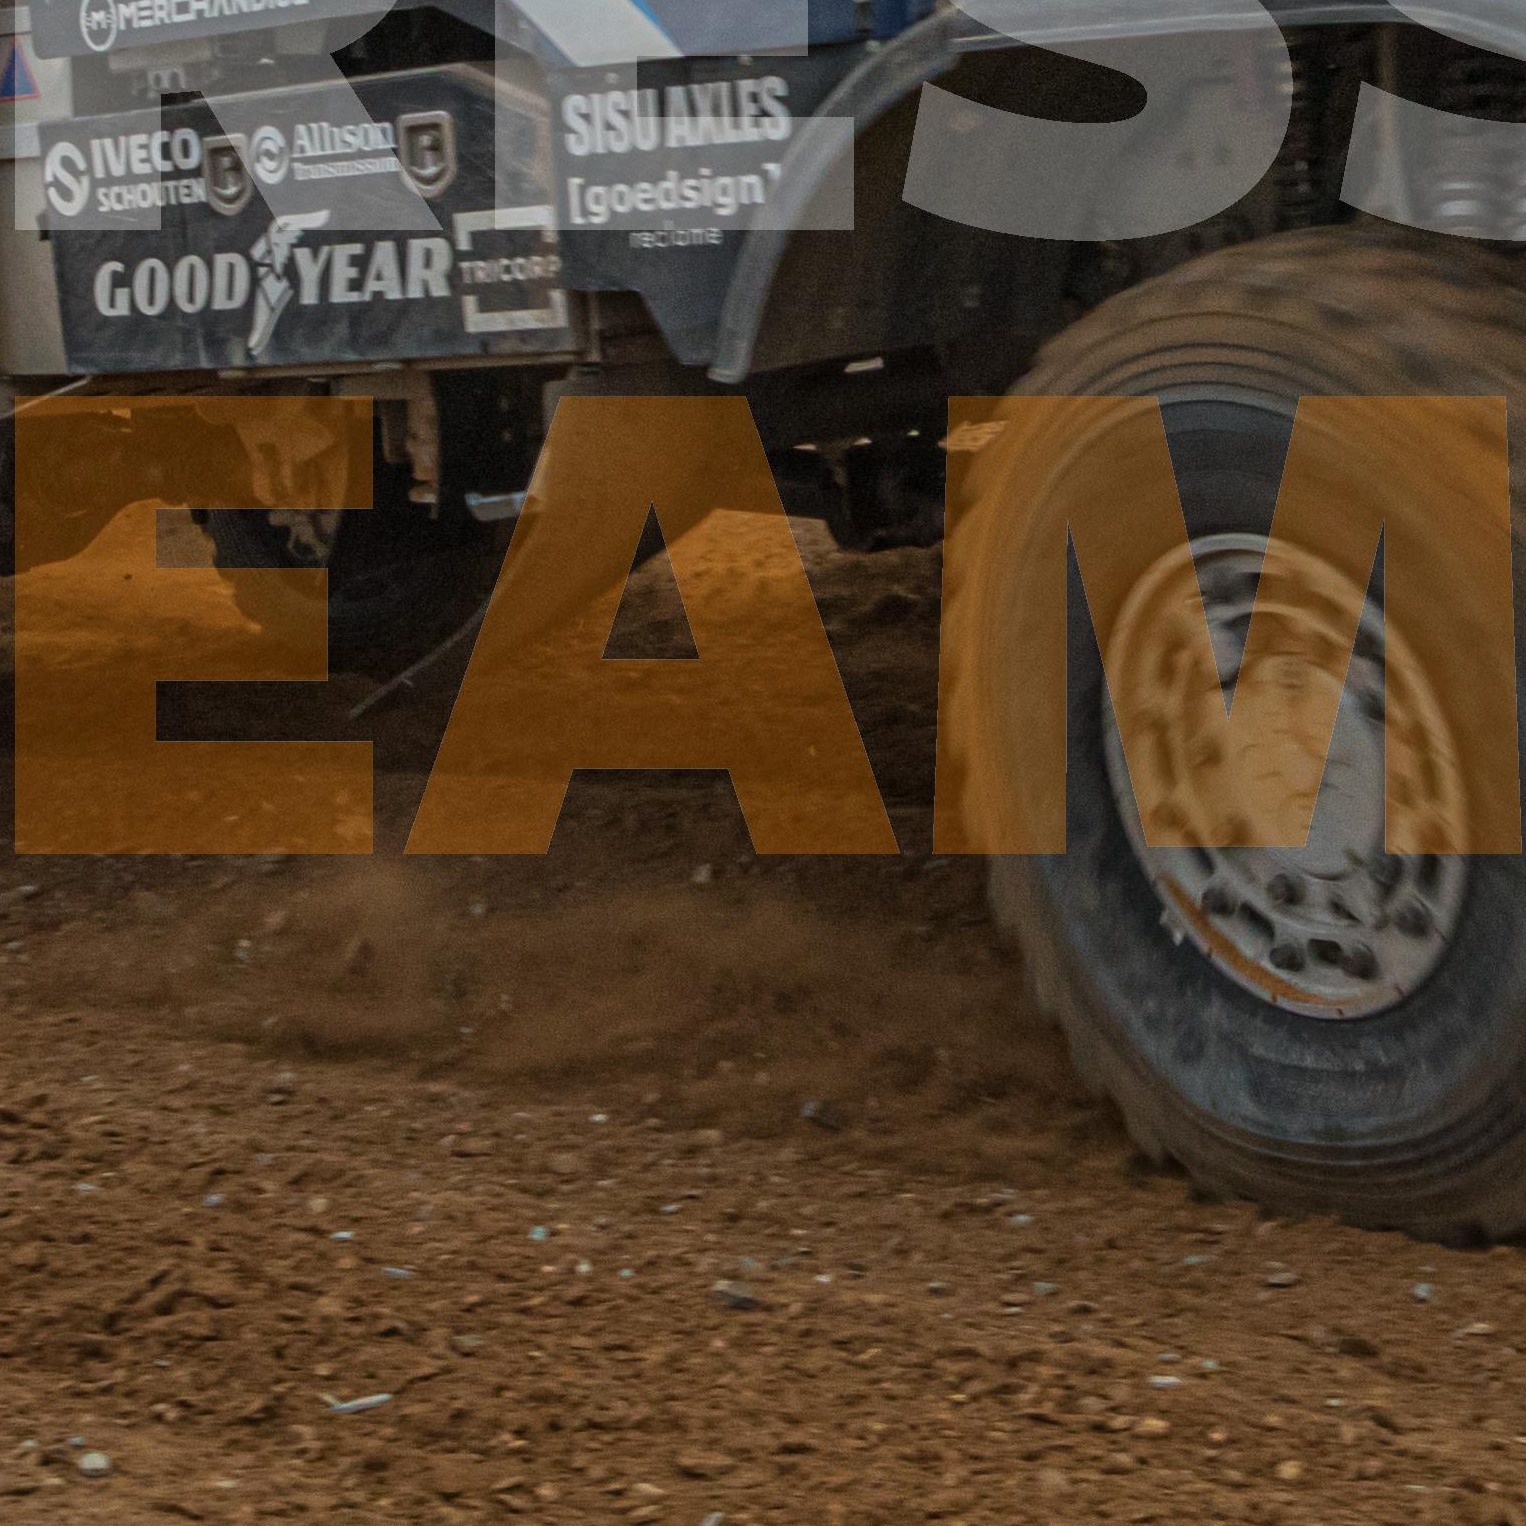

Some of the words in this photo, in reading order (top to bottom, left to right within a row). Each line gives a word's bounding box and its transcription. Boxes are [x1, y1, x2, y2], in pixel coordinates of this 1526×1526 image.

[561, 87, 661, 157] SISU
[664, 76, 792, 149] AXLES
[90, 127, 203, 179] IVECO
[293, 120, 398, 159] Allison
[97, 177, 209, 213] SCHOUTEN
